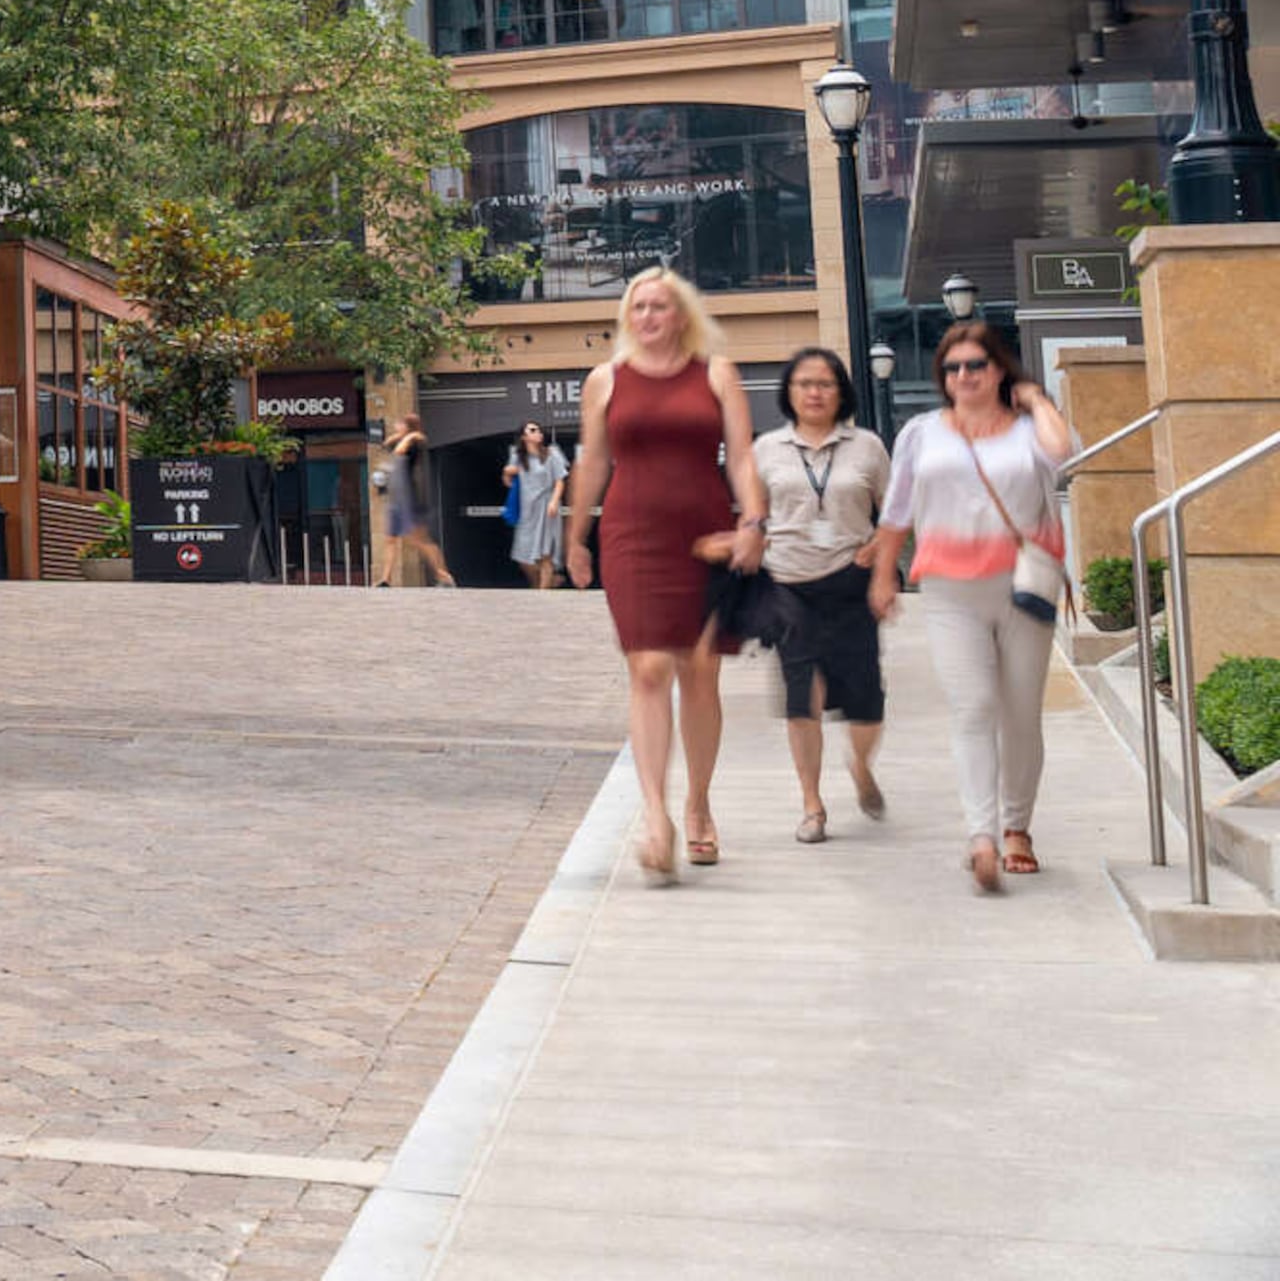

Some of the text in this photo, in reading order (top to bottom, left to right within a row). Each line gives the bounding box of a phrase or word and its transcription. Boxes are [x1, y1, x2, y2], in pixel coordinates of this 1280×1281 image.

[506, 193, 541, 207] NEW
[612, 184, 648, 199] LIVE
[653, 182, 689, 195] AND
[526, 379, 582, 404] THE
[257, 397, 344, 416] BONOBOS
[152, 530, 224, 542] NO LEFT TURN
